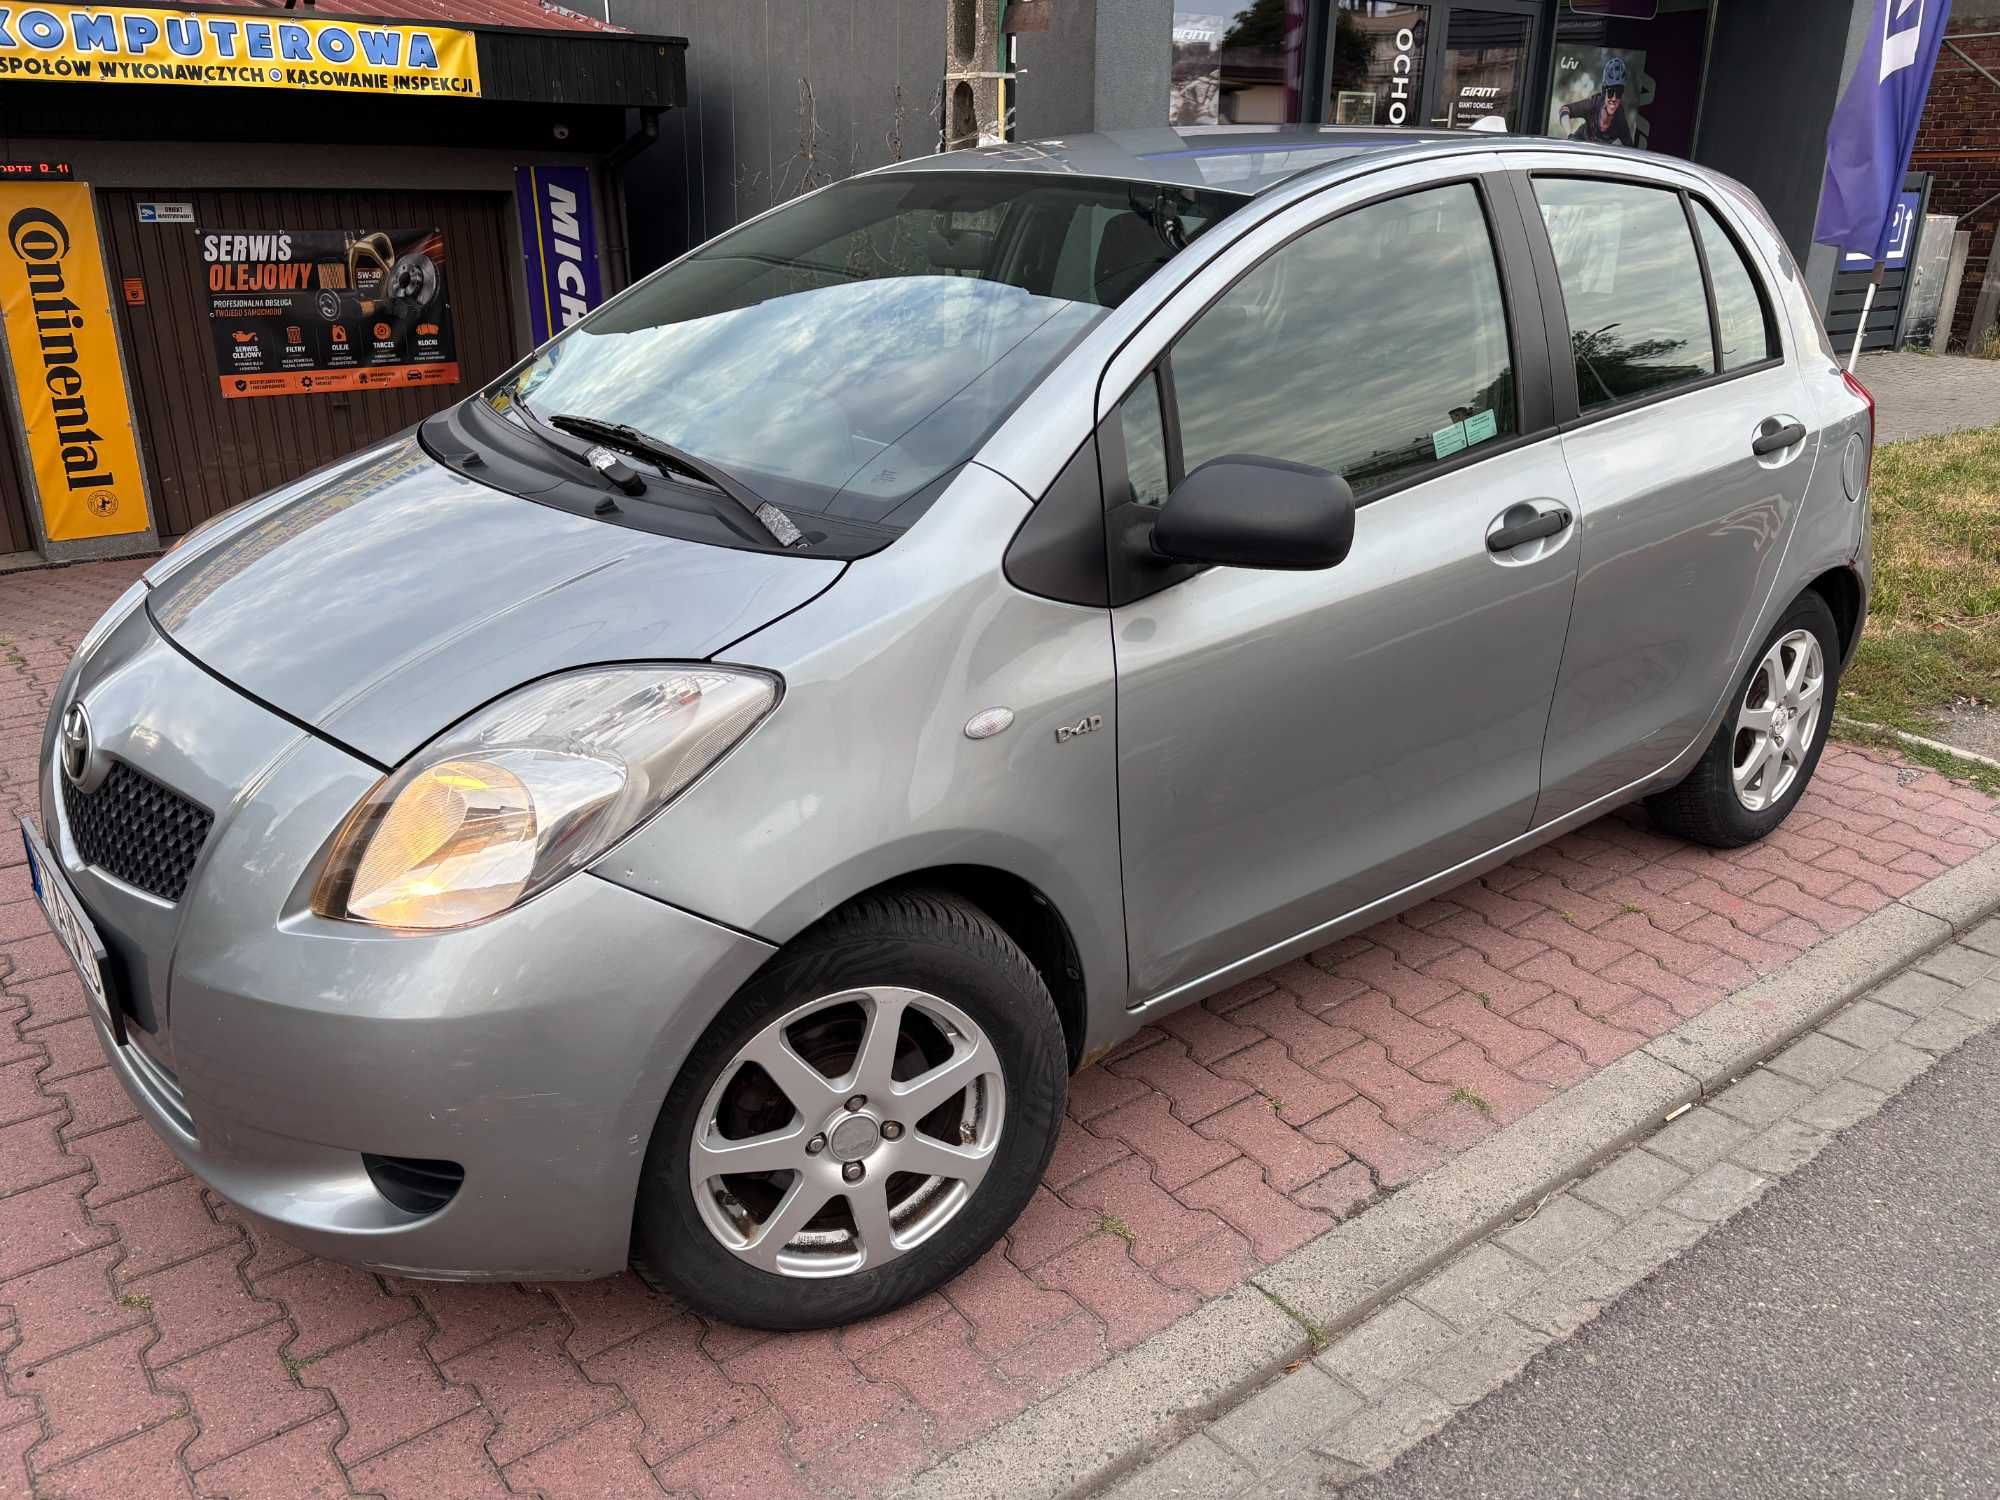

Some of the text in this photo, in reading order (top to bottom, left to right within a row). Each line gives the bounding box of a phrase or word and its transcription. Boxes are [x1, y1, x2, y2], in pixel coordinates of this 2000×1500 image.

[1560, 56, 1580, 70] Liv
[0, 56, 474, 93] SPOŁÓW WYKONAWCZYCH KASOWANIE INSPEKCJI
[1460, 86, 1501, 97] GIANT
[1458, 101, 1472, 109] GIANT
[203, 235, 292, 262] SERWIS
[209, 263, 312, 291] OLEJOWY
[357, 271, 381, 279] 5W-30
[213, 299, 264, 308] PROFESJONALNA
[8, 207, 114, 491] Continental
[1055, 714, 1104, 744] D-4D
